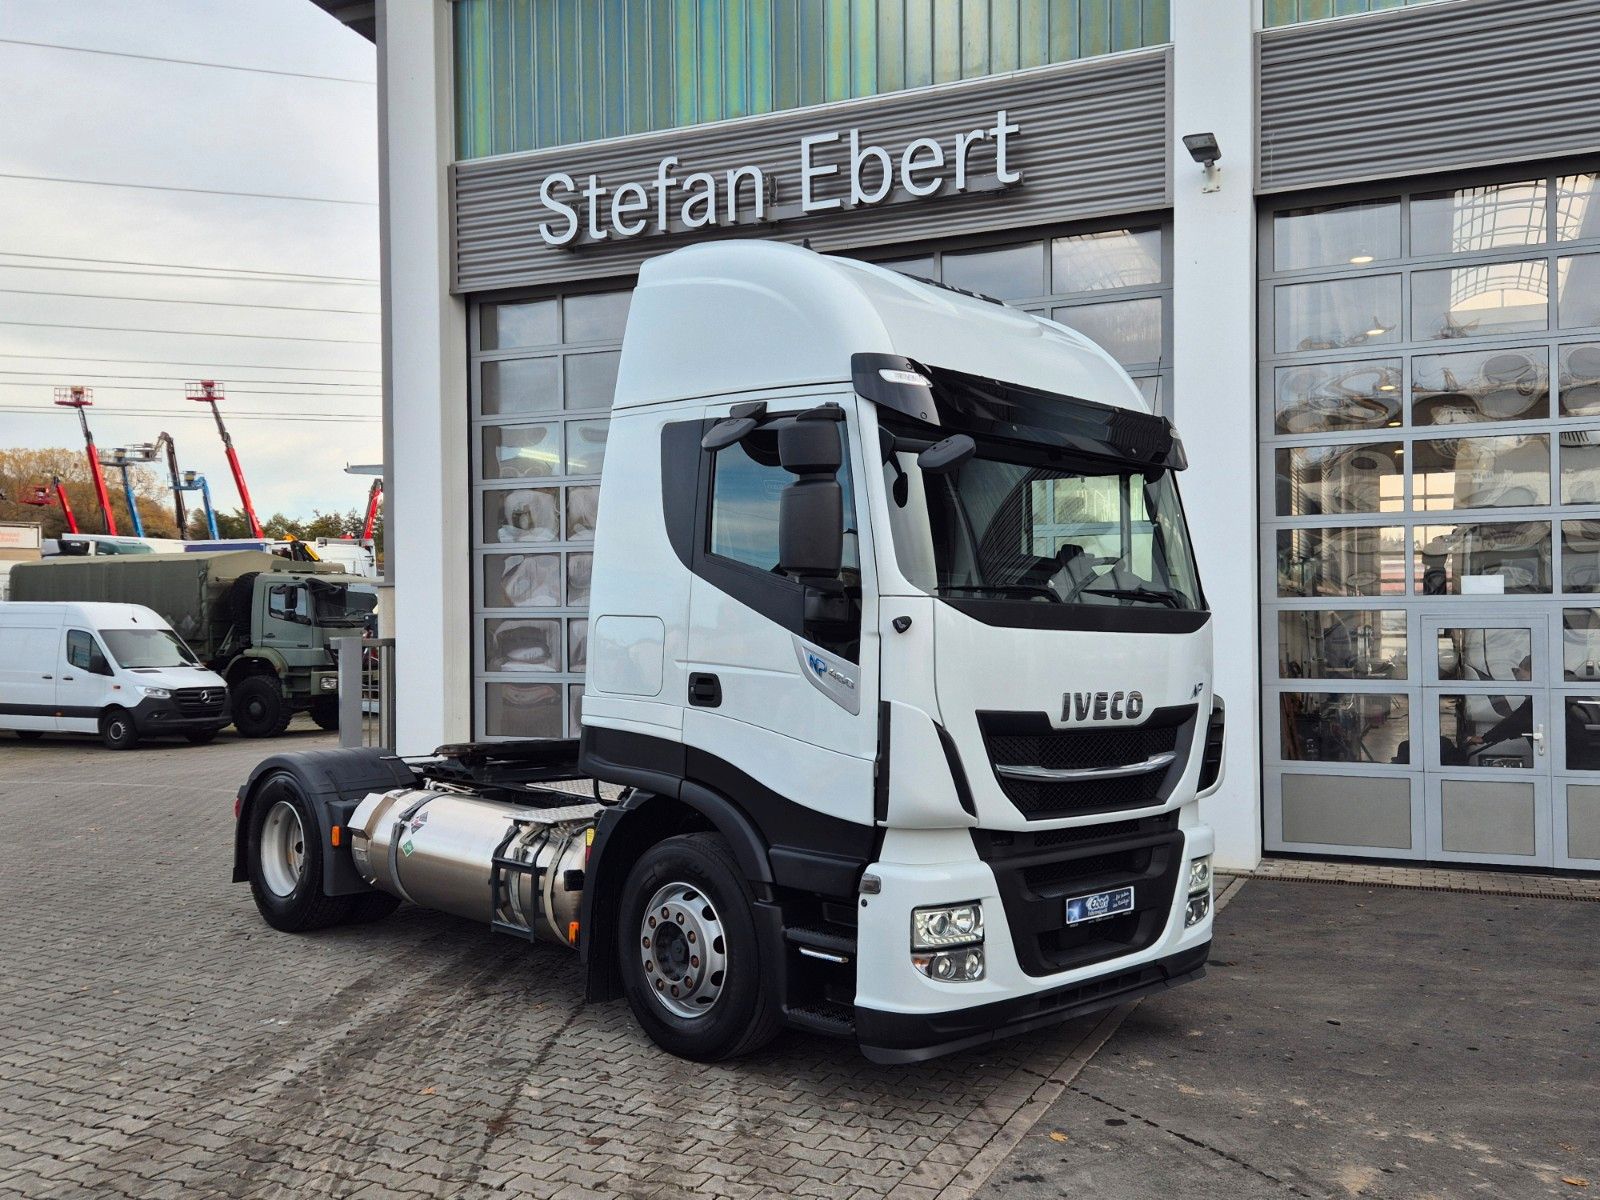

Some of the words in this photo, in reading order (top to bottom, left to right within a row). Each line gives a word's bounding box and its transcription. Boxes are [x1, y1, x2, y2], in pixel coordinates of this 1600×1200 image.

[538, 155, 766, 246] Stefan
[800, 110, 1022, 213] Ebert
[1060, 690, 1144, 722] IVECO
